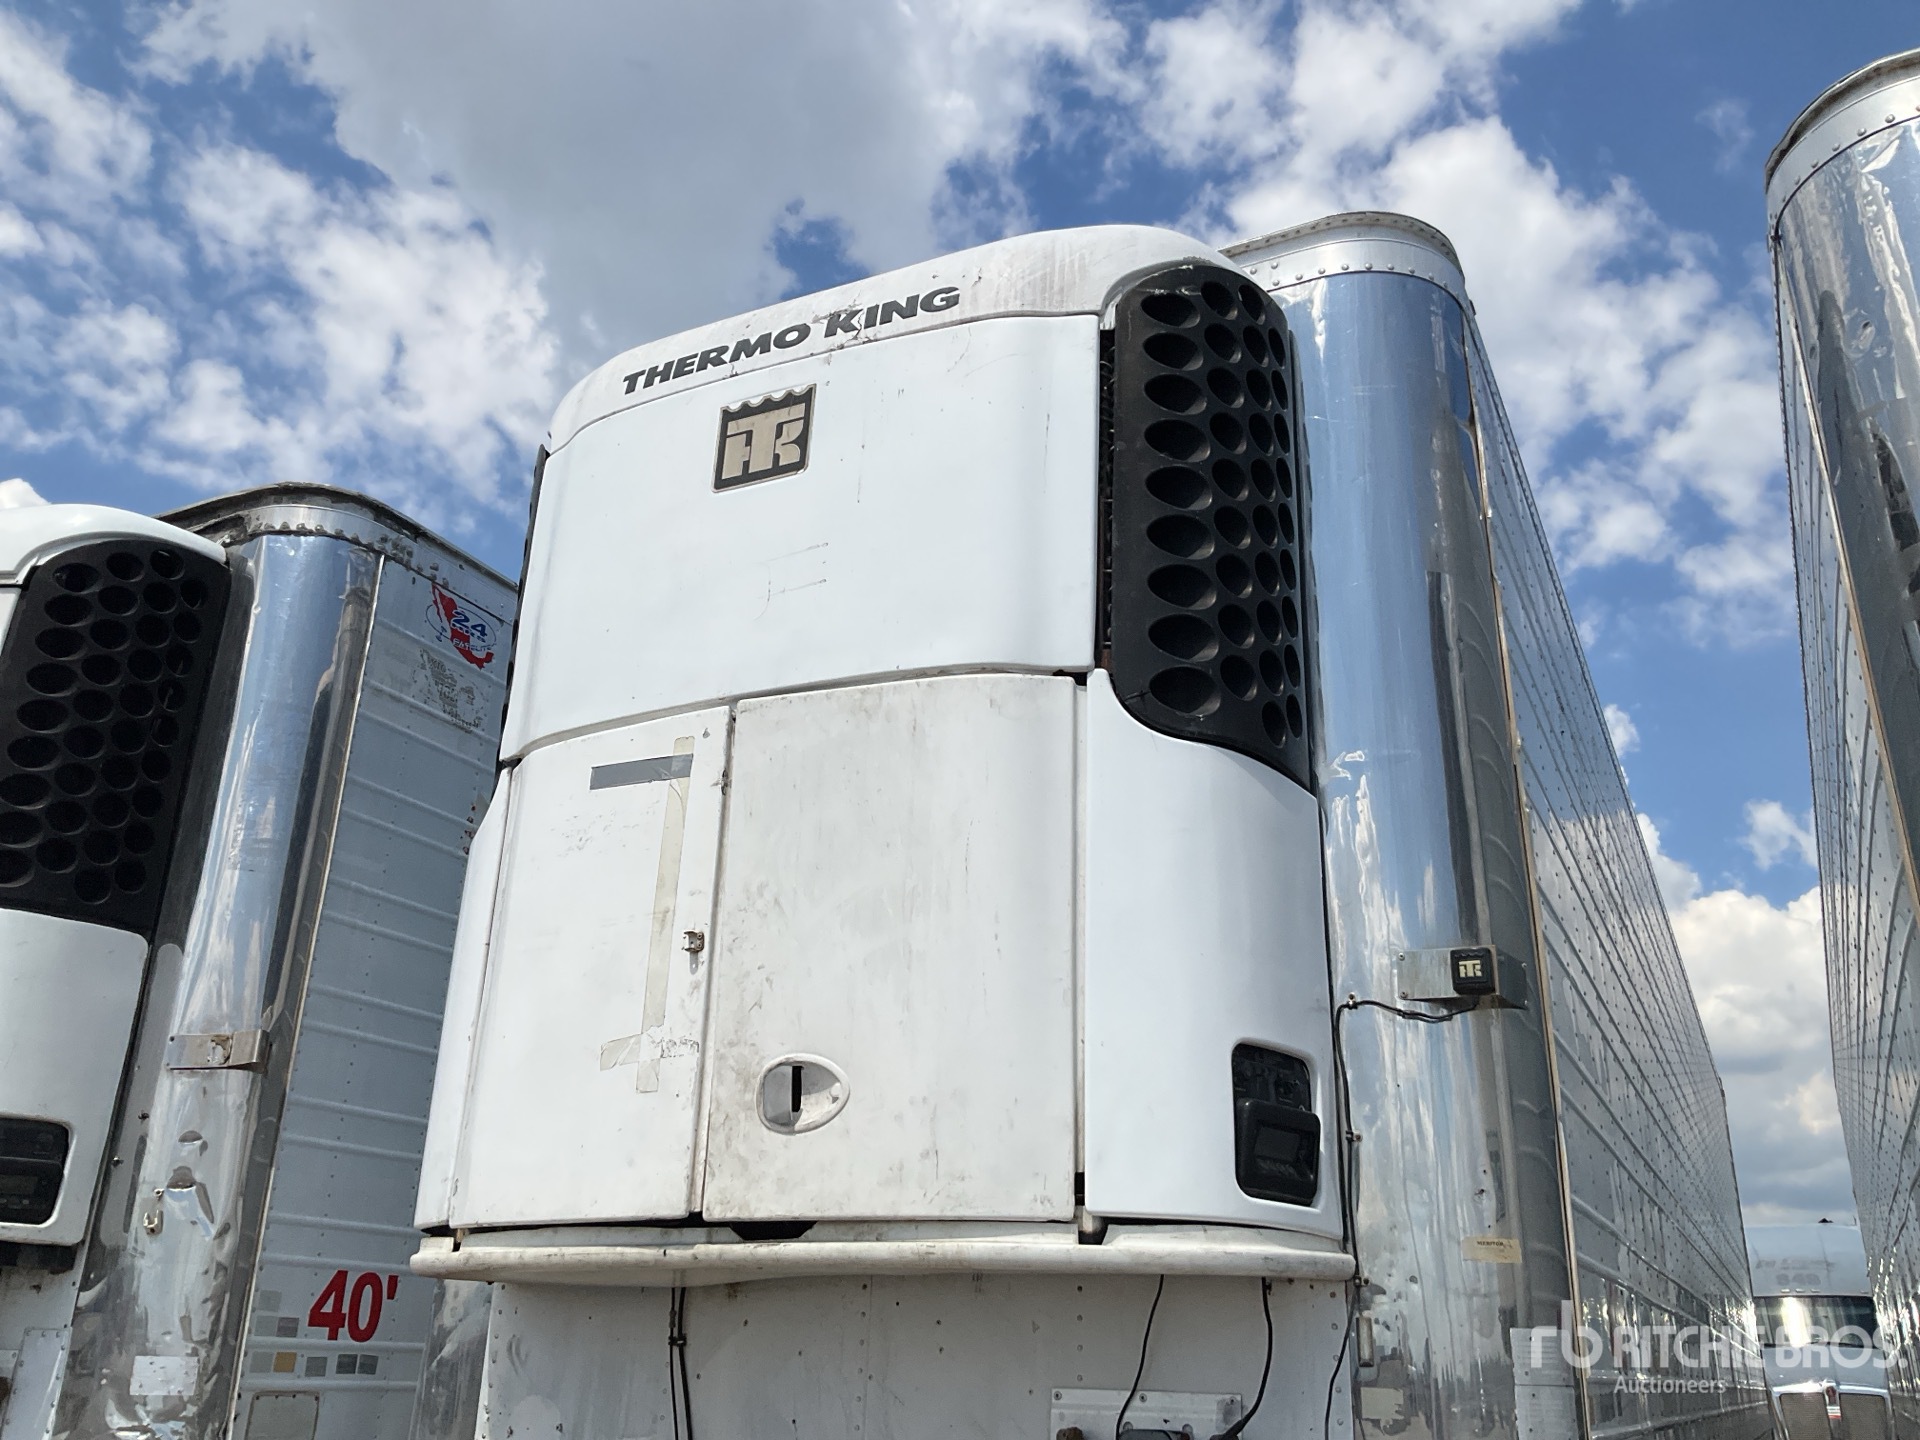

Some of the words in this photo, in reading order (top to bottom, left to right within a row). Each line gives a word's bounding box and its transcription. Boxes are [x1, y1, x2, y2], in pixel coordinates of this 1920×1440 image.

[623, 323, 809, 394] THERMO
[824, 286, 960, 339] KING
[451, 610, 488, 637] 24
[307, 1269, 399, 1343] 40'
